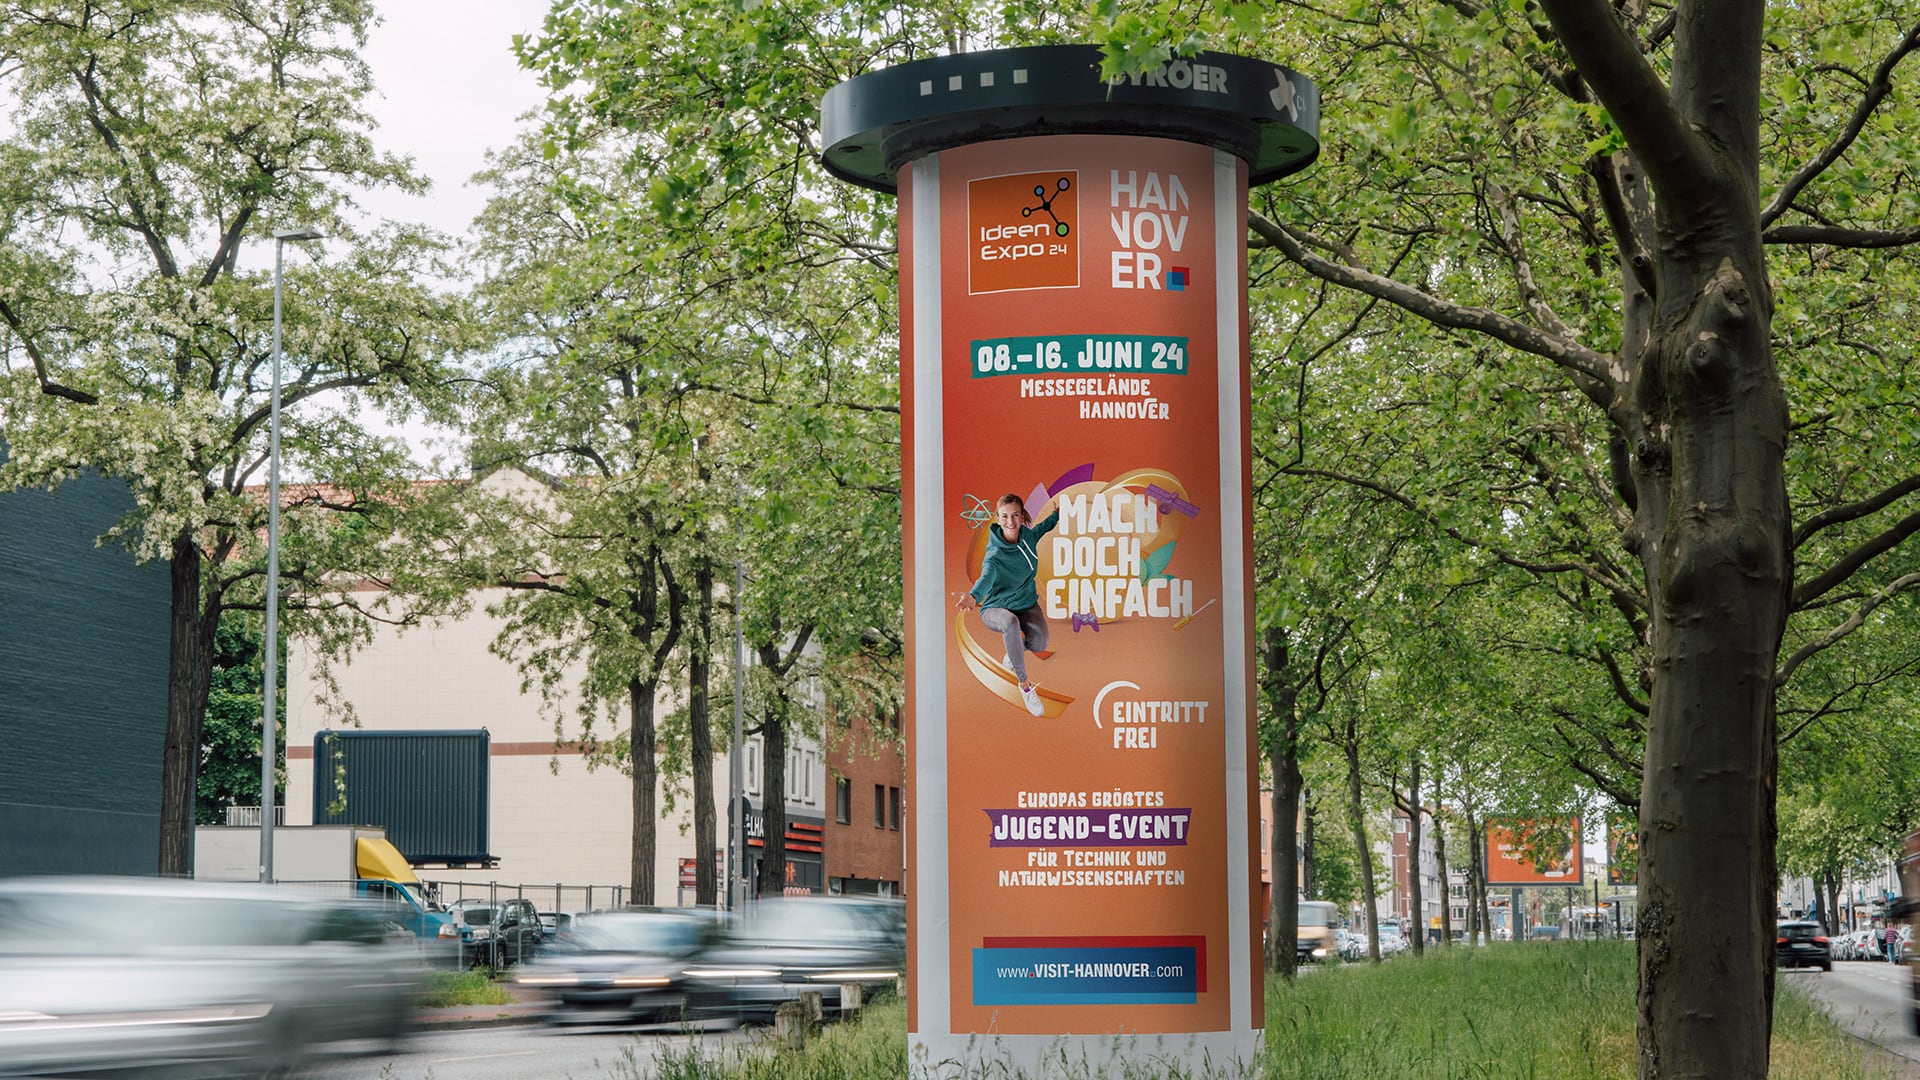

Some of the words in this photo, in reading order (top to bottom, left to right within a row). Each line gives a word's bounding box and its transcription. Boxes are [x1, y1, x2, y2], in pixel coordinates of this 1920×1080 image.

[1110, 169, 1190, 212] HAN
[980, 223, 1051, 242] Ideen
[1111, 211, 1190, 252] NOV
[980, 243, 1045, 261] Expo
[1049, 244, 1068, 255] 24
[1111, 251, 1162, 290] ER
[977, 341, 1068, 372] 08.-16.
[1077, 338, 1143, 369] JUNI
[1151, 342, 1184, 370] 24
[1020, 373, 1151, 398] MESSEGELÄNDE
[1079, 398, 1170, 420] HANNOVER
[1058, 493, 1159, 535] MACH
[1052, 536, 1142, 577] DOCH
[1046, 578, 1193, 619] EINFACH
[1113, 701, 1209, 723] EINTRITT
[1113, 727, 1158, 749] FREI
[1018, 791, 1087, 808] EUROPAS
[994, 813, 1189, 840] JUGEND-EVENT
[1028, 848, 1058, 867] FÜR
[1064, 850, 1131, 867] TECHNIK
[1136, 850, 1167, 866] UND
[999, 870, 1185, 887] NATURWISSENSCHAFTEN
